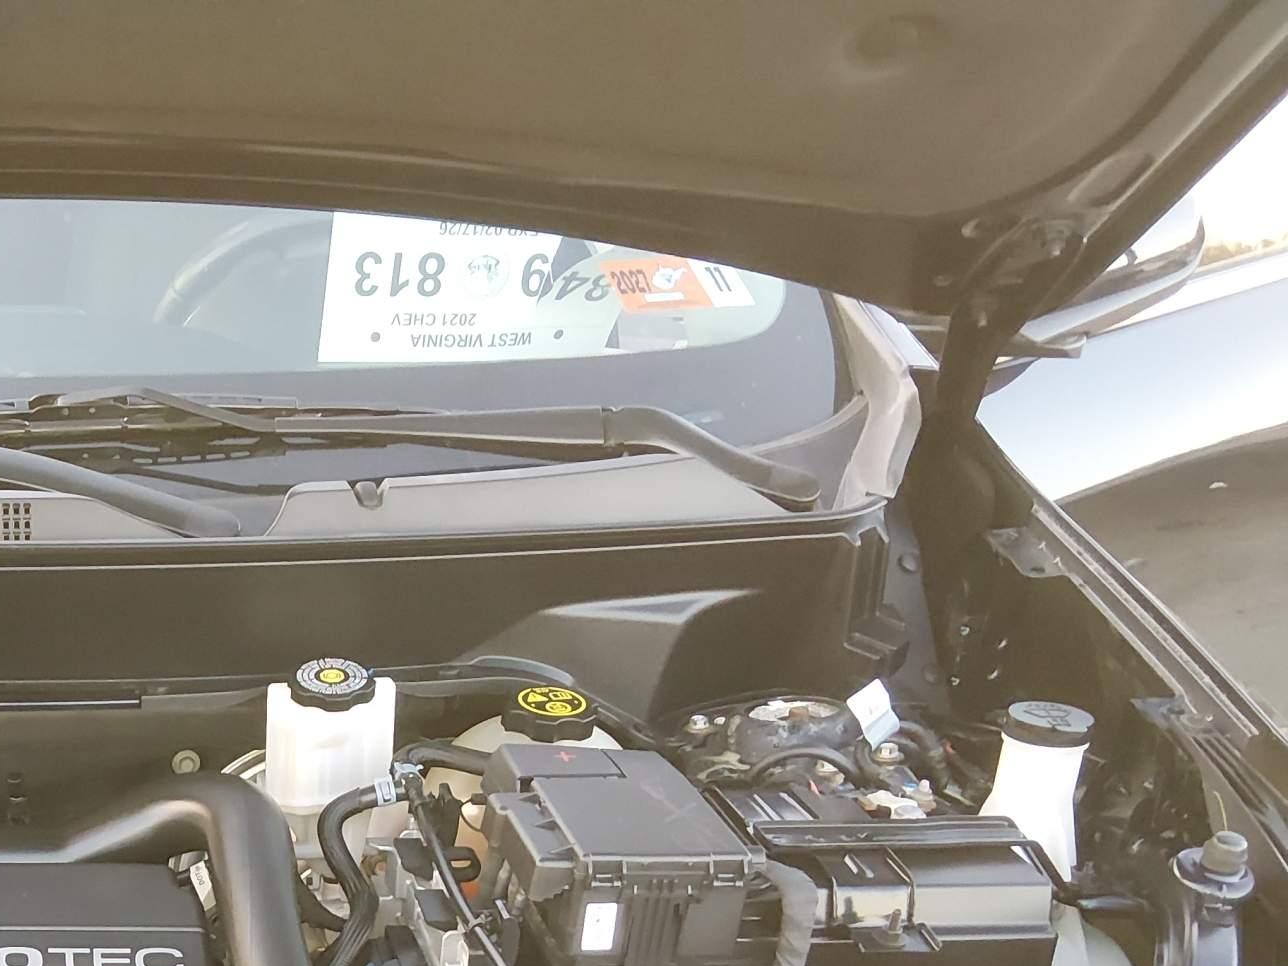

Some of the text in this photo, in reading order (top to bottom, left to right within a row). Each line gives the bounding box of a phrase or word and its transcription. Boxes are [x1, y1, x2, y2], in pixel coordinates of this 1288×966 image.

[354, 251, 446, 297] 813
[390, 312, 477, 327] 2021 CHEV
[410, 331, 532, 348] WEST VIRGINIA
